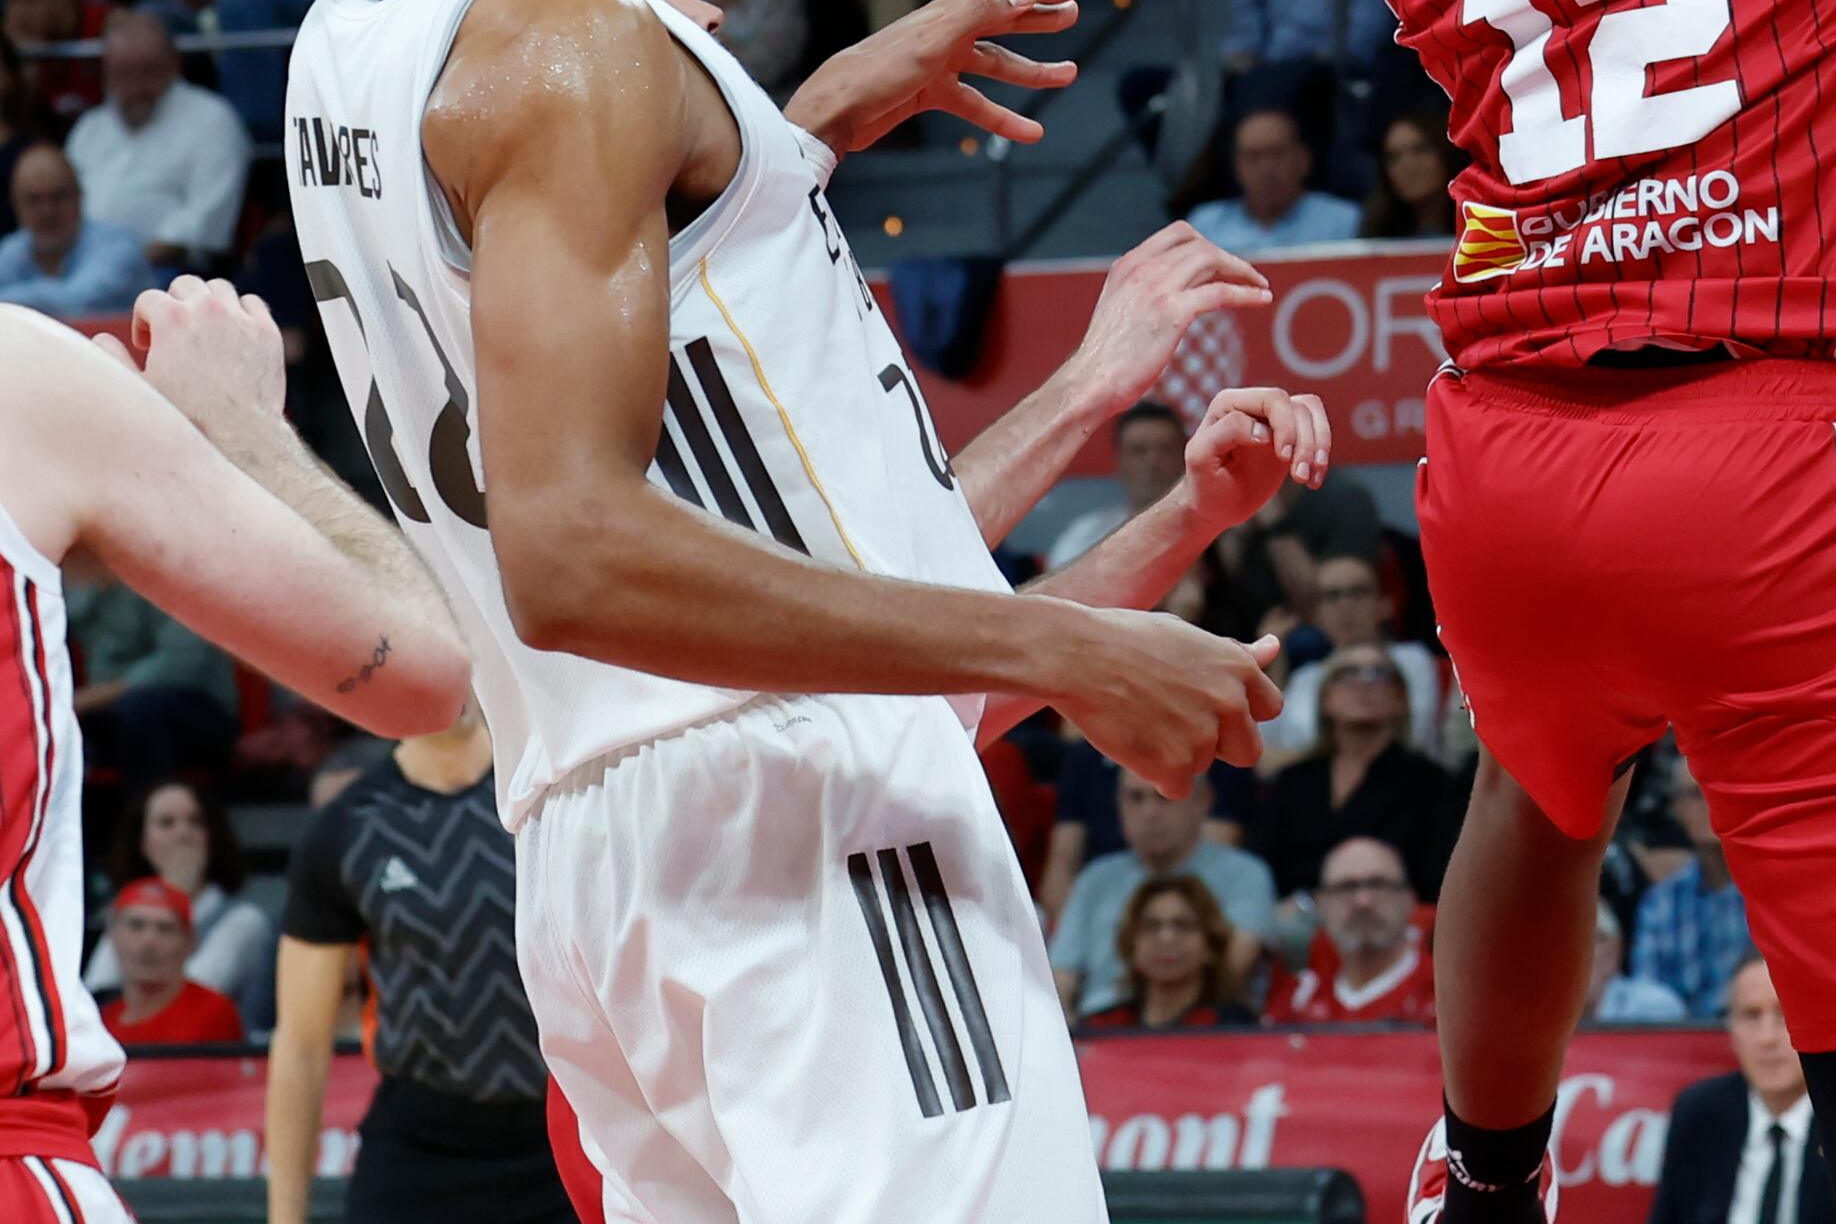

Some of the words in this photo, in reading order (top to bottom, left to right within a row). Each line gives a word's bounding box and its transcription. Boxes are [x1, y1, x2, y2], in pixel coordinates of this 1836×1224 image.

[1517, 233, 1573, 271] DE
[1579, 206, 1779, 265] ARAGON
[1272, 276, 1447, 380] OR
